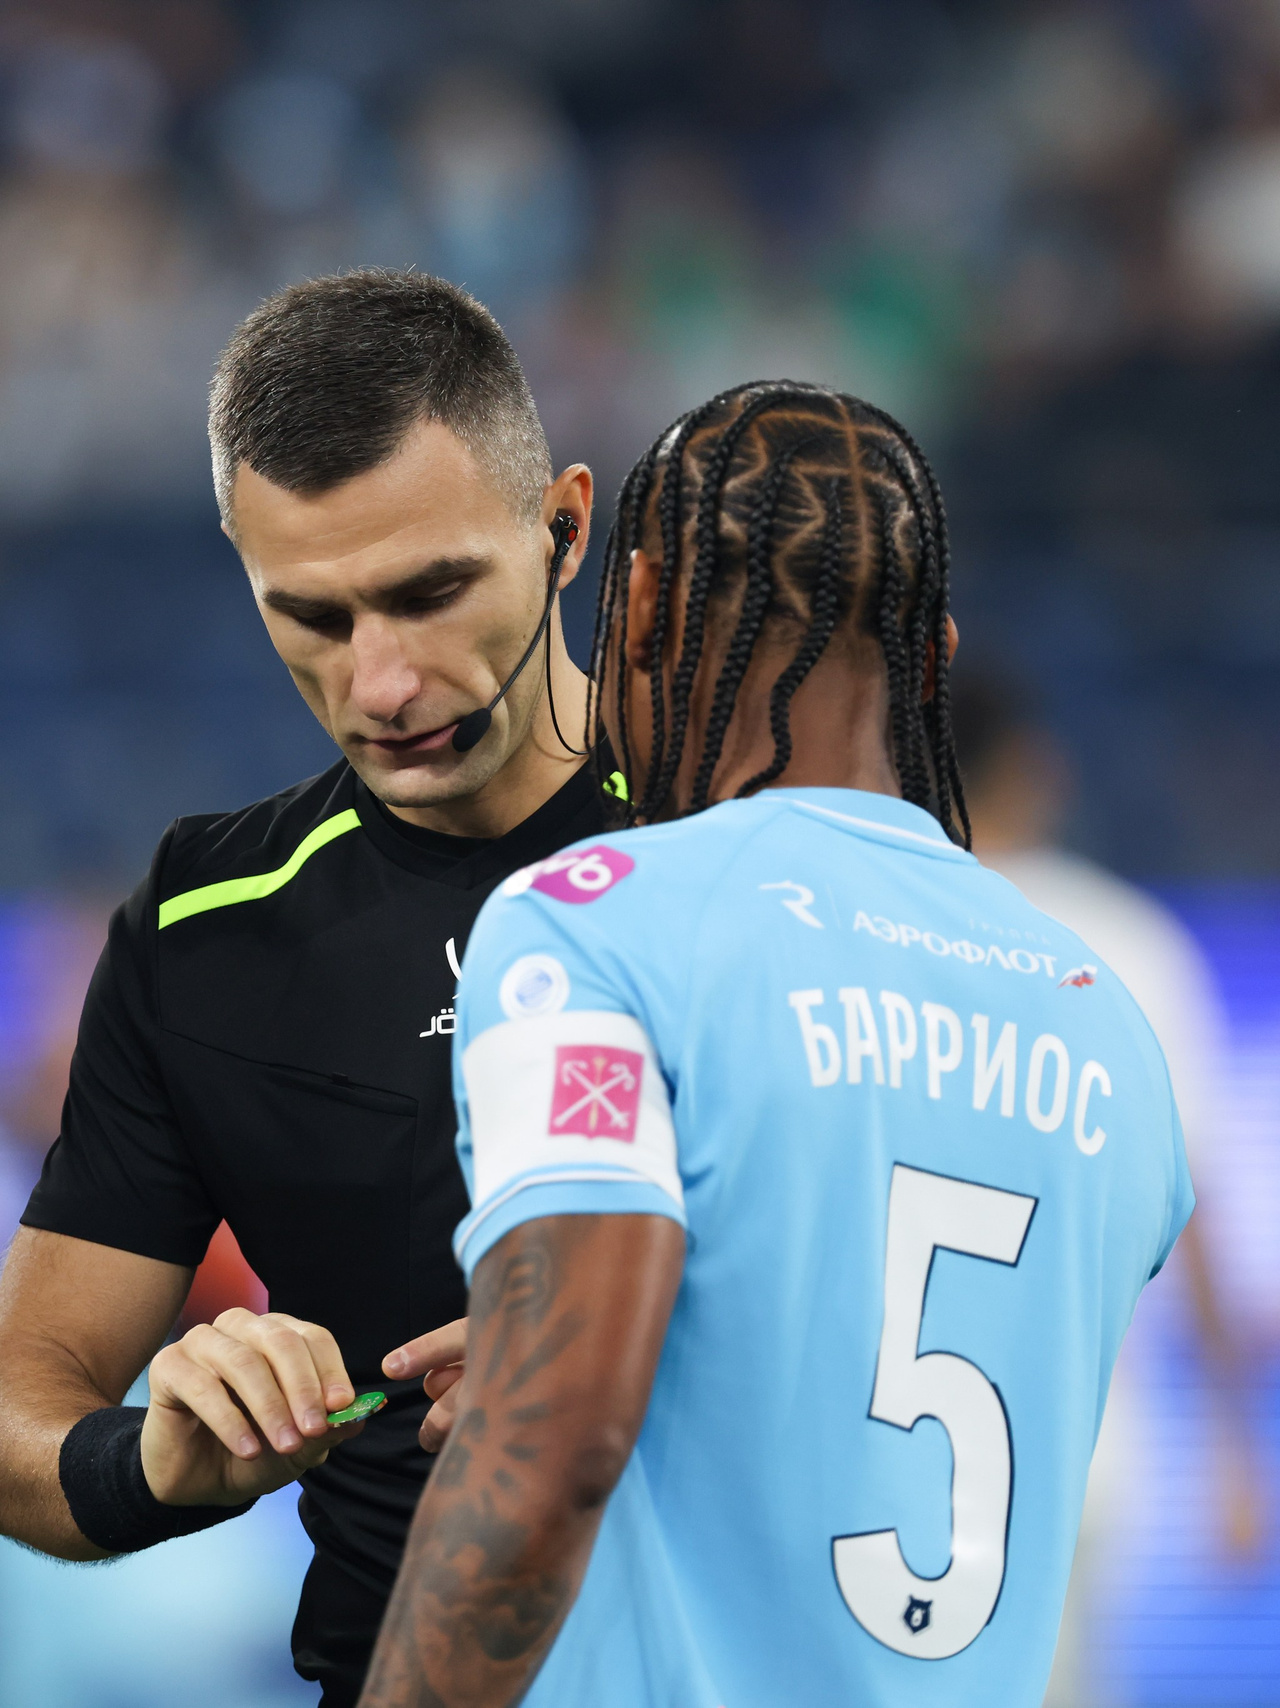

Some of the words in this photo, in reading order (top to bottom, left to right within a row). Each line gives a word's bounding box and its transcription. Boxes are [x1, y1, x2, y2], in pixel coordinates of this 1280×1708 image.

[852, 909, 1058, 979] АЭРОФЛОТ
[787, 986, 1113, 1157] БАРРИОС
[831, 1160, 1040, 1662] 5
